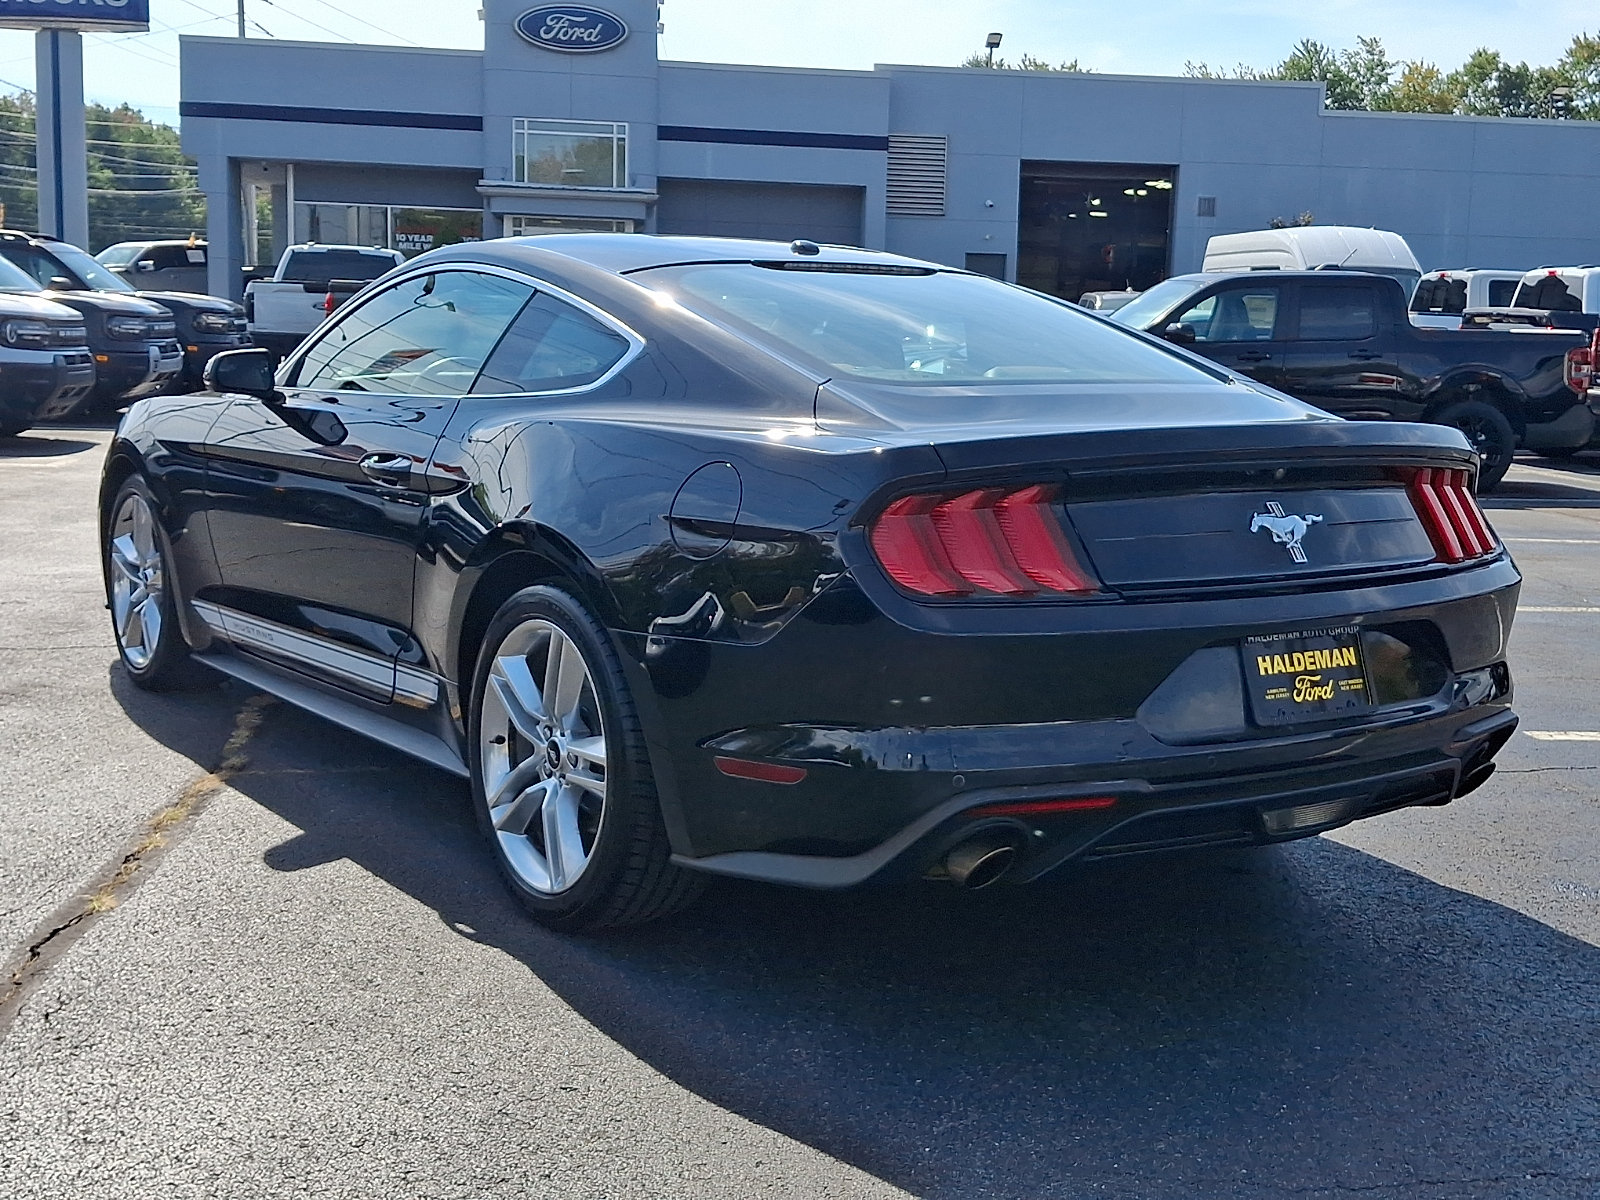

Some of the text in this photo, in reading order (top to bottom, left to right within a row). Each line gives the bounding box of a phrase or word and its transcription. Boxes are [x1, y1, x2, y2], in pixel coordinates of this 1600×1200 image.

[540, 14, 602, 42] Ford
[395, 233, 434, 242] 10 YEAR
[398, 242, 420, 250] MILE
[1257, 647, 1357, 676] HALDEMAN
[1293, 675, 1335, 703] Ford
